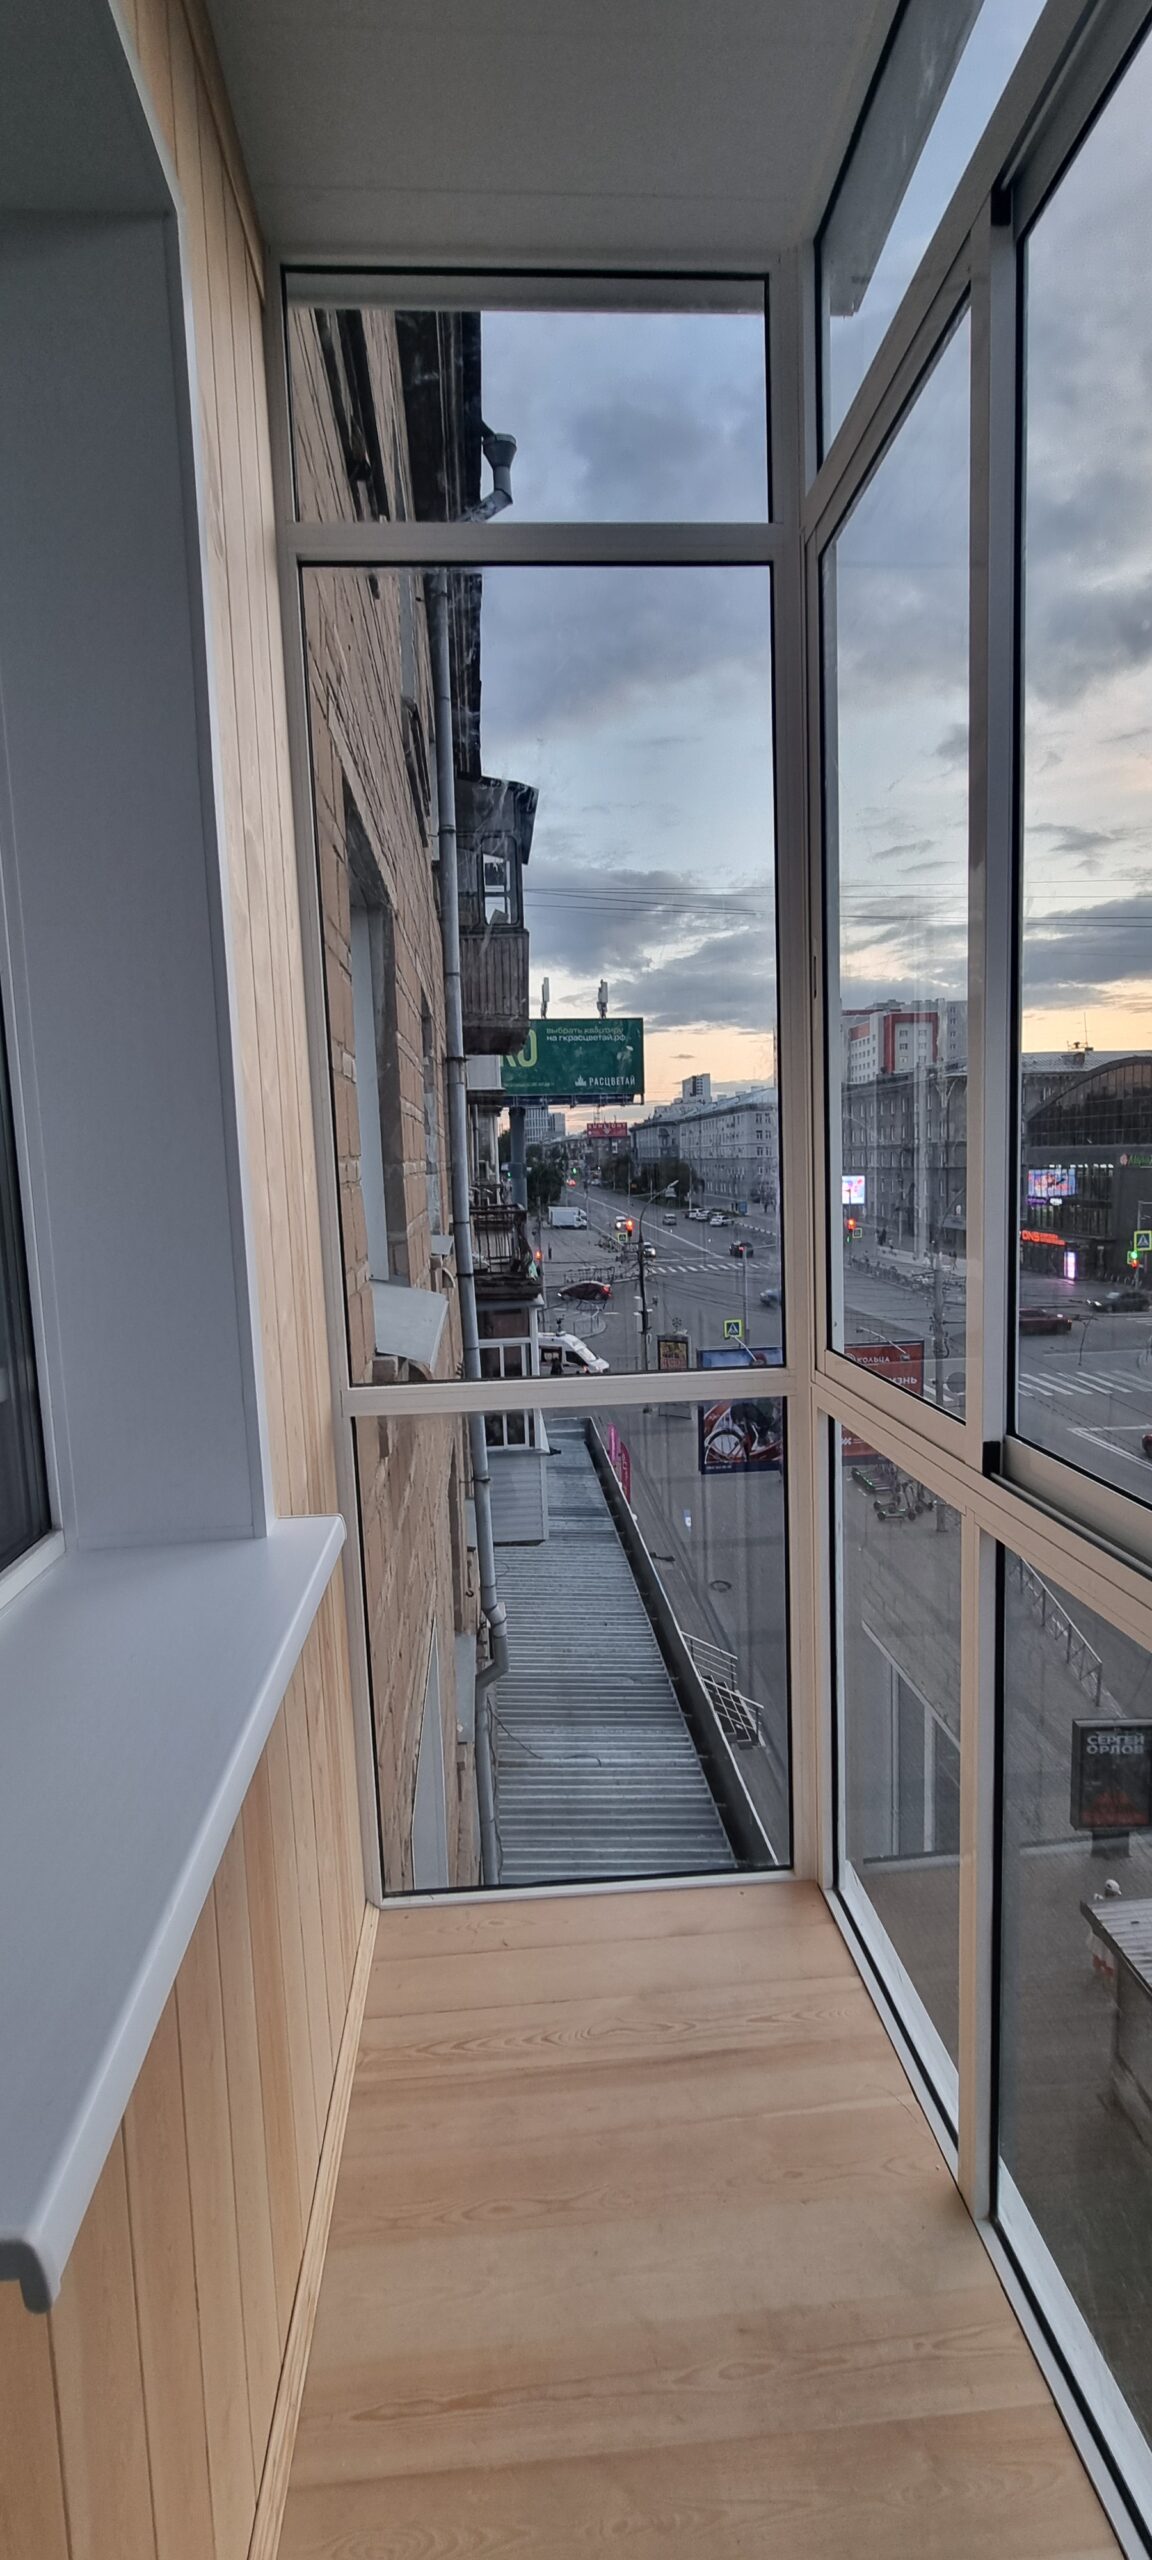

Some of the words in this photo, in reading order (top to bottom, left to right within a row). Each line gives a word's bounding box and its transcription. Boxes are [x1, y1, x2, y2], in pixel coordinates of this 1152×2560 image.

[546, 1027, 583, 1035] выбрать
[589, 1075, 635, 1087] РАСЦВЕТАЙ
[1087, 1733, 1145, 1745] СЕРГЕЙ
[1087, 1745, 1144, 1754] ОРЛОВ
